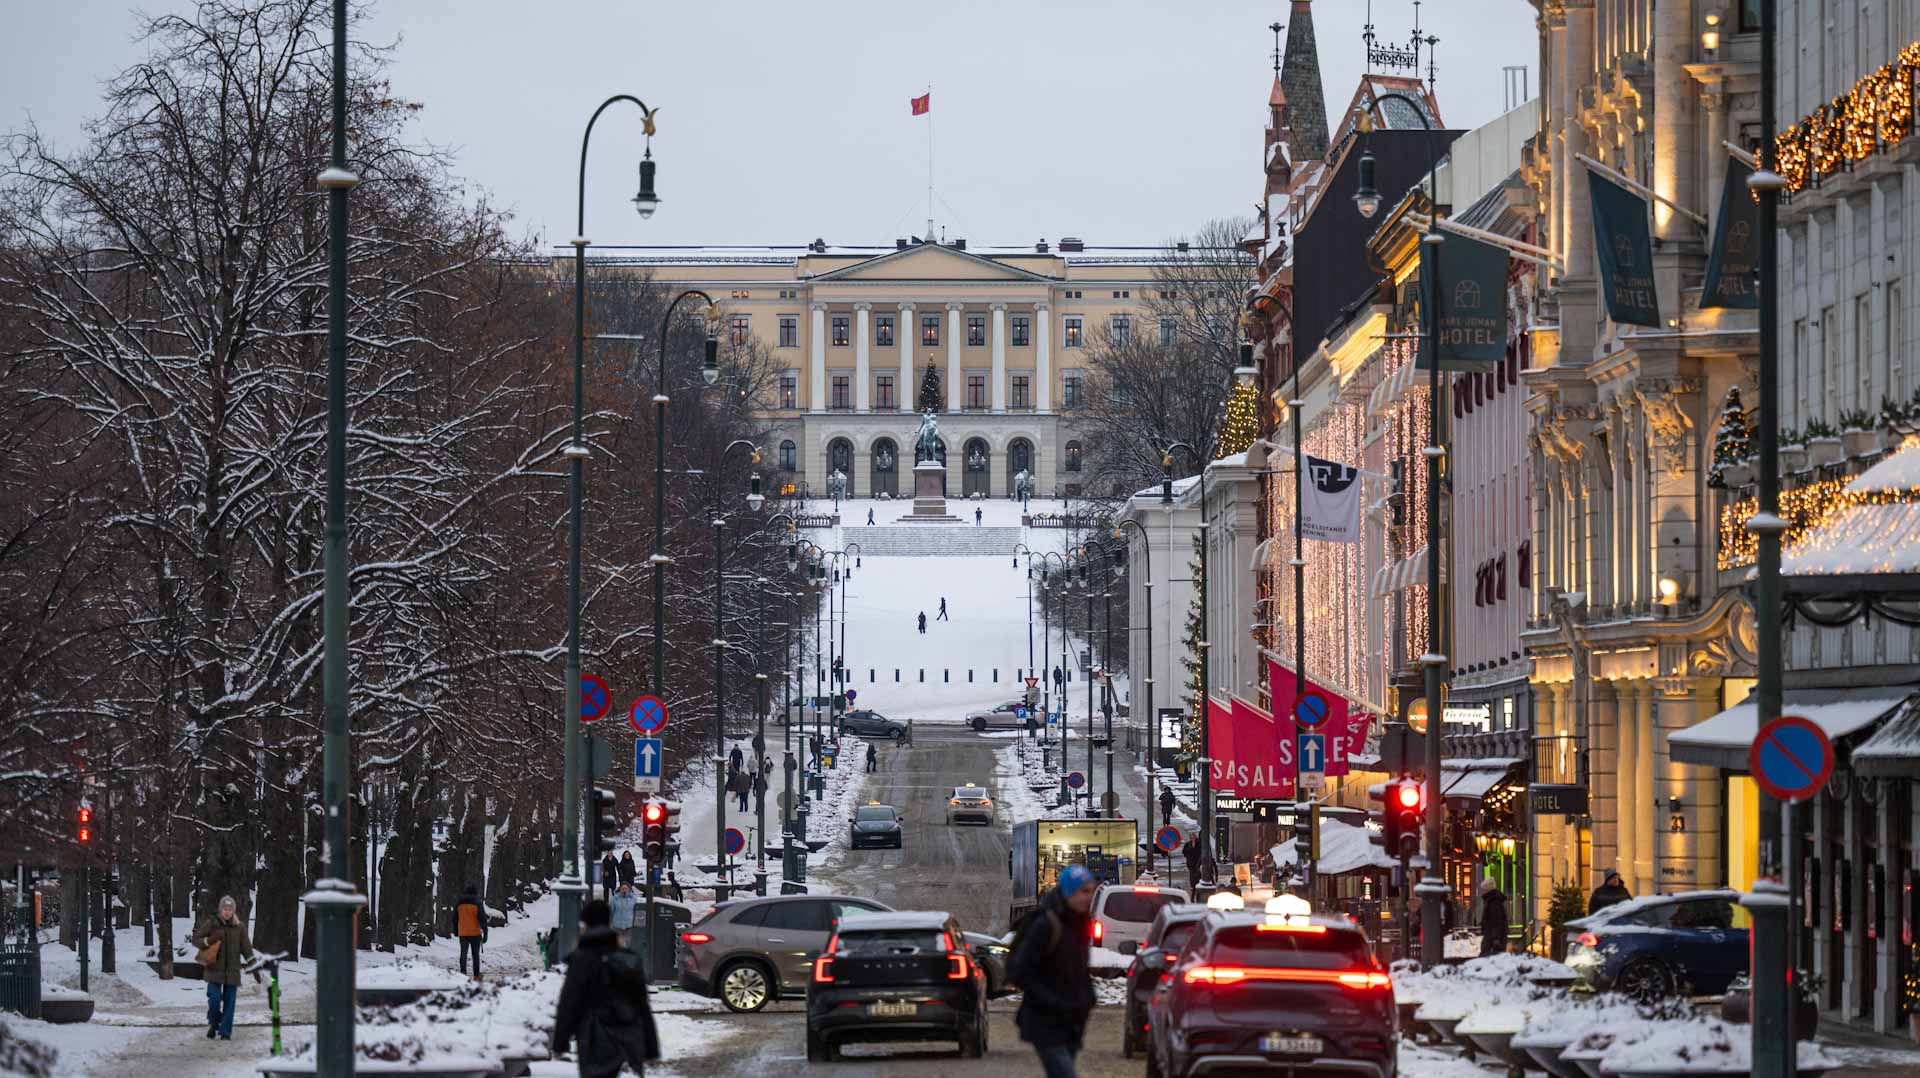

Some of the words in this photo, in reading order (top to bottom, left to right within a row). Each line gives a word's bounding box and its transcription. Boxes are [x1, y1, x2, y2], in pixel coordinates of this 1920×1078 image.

[1615, 288, 1655, 309] HOTEL
[1440, 328, 1496, 345] HOTEL
[1213, 759, 1236, 780] SA
[1216, 799, 1241, 809] PALEET
[1533, 795, 1561, 810] HOTEL
